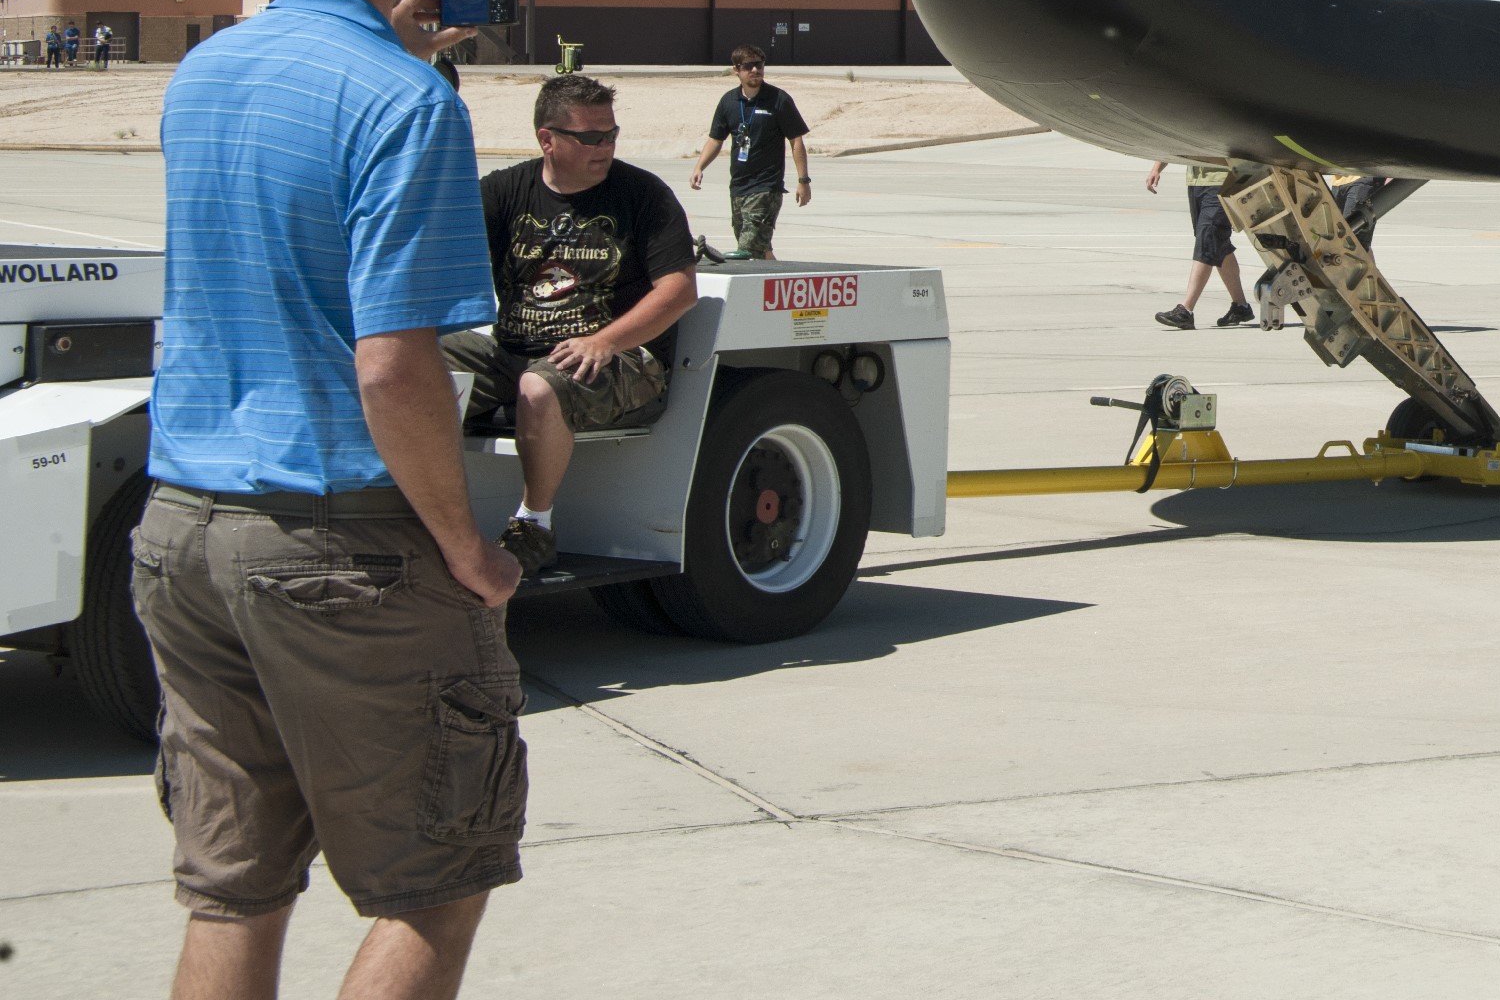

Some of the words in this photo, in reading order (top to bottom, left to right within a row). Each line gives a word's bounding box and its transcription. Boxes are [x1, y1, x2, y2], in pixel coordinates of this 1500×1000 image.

[548, 244, 609, 260] Marines
[0, 263, 119, 284] WOLLARD
[764, 276, 858, 310] JV8M66
[912, 289, 929, 298] 59-01
[510, 303, 585, 322] American
[32, 452, 67, 469] 59-01
